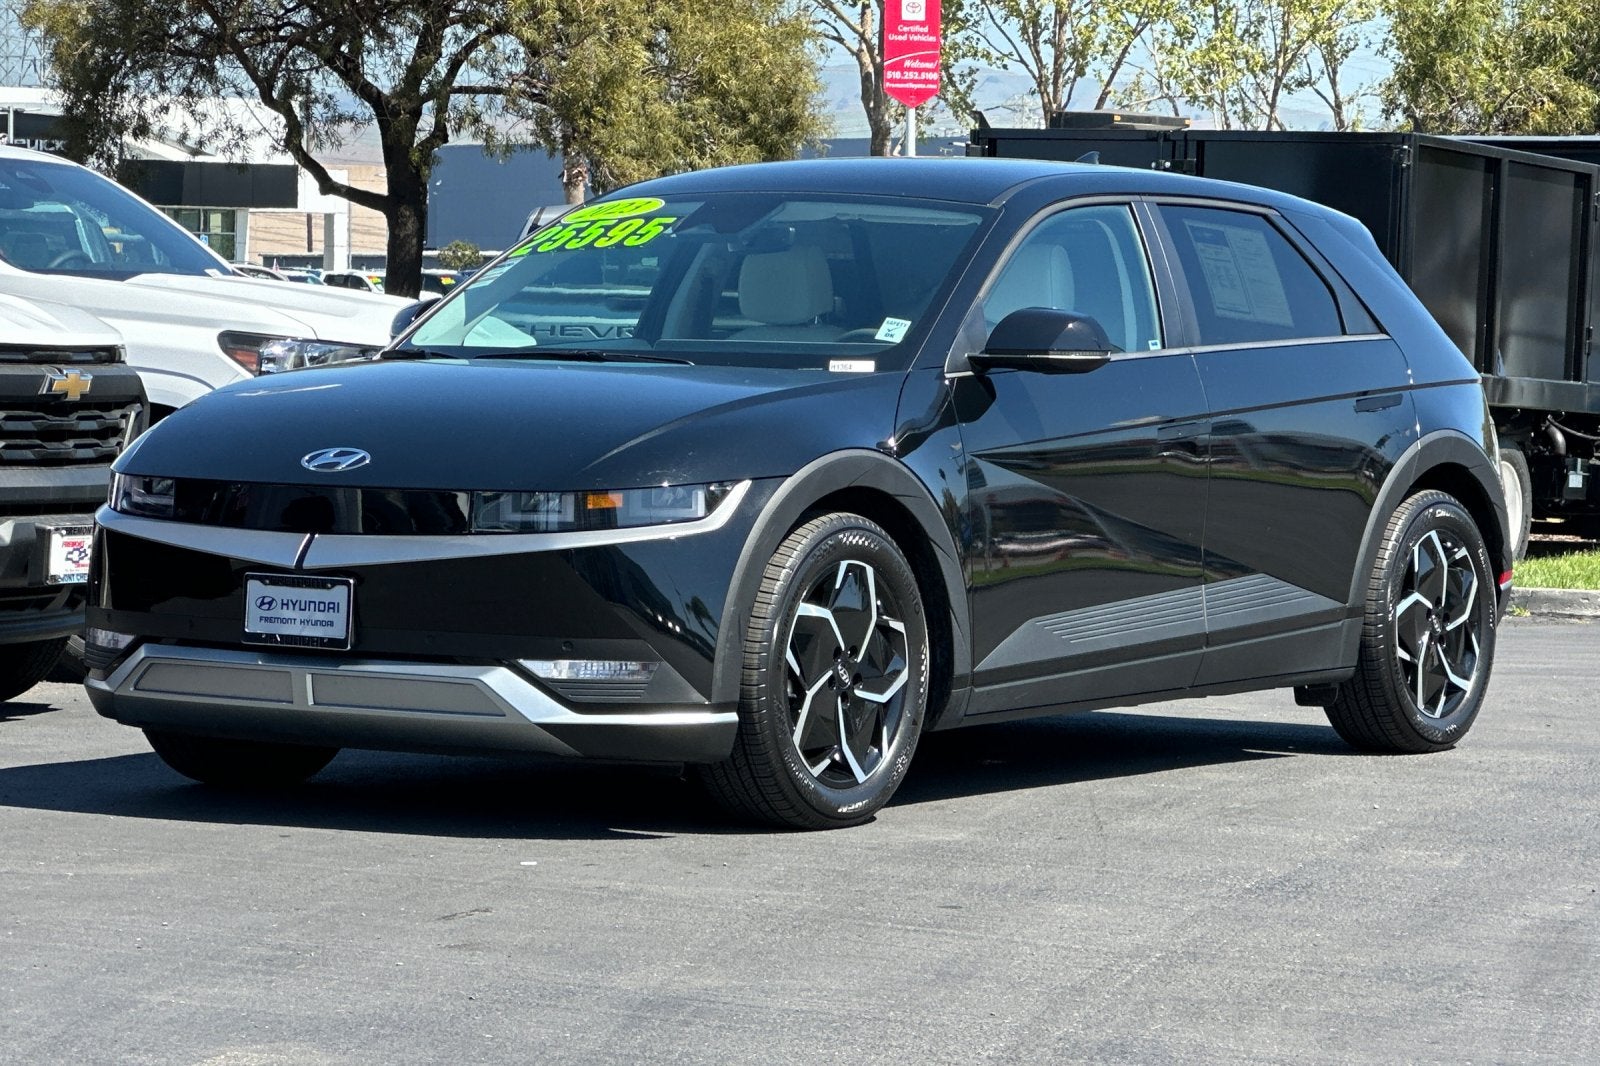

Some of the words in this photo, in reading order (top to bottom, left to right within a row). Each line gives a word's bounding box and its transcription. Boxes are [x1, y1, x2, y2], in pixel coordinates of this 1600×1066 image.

[897, 24, 929, 33] Certified
[888, 33, 908, 41] Used
[908, 34, 937, 42] Vehicles
[903, 60, 938, 69] Welcome!
[507, 217, 678, 258] 25595
[885, 319, 908, 328] SAFETY
[280, 598, 340, 614] HYUNDAI
[259, 615, 297, 625] FREMONT
[299, 619, 335, 628] HYUNDAI
